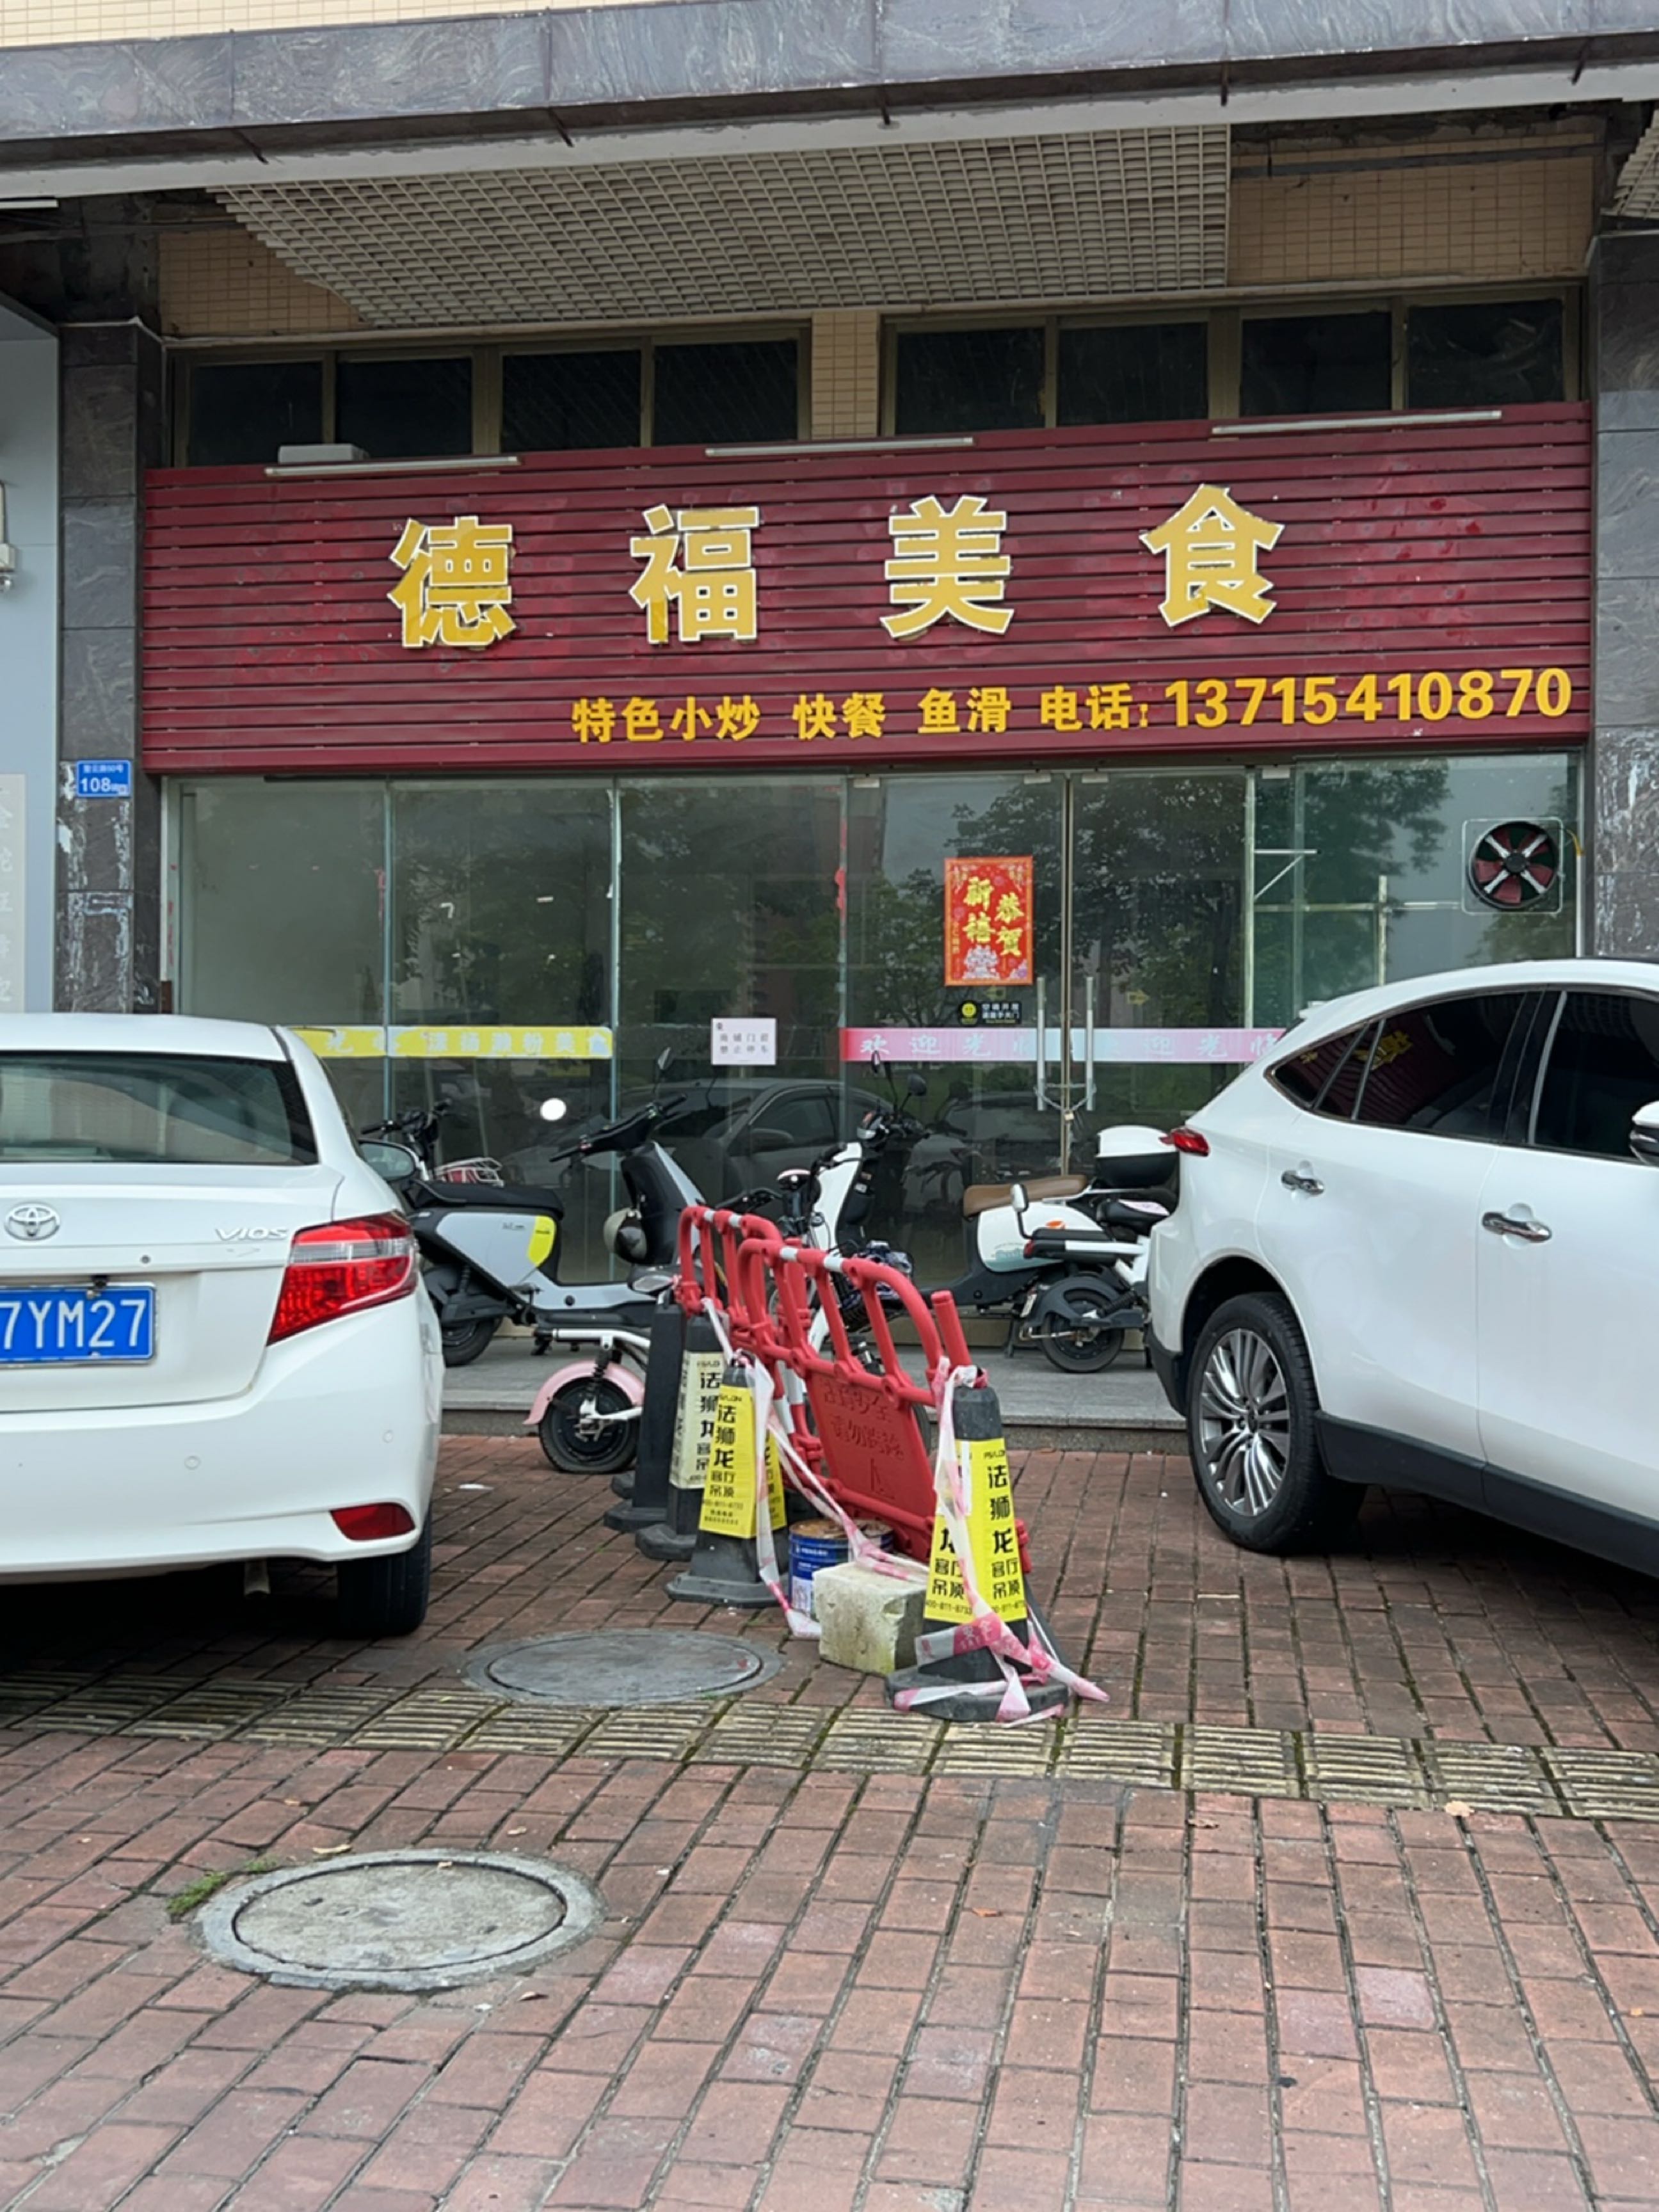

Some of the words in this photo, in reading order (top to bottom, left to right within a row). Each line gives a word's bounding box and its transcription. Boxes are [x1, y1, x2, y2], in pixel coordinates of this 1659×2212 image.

[387, 484, 1285, 648] 德福美食
[572, 695, 761, 743] 特色小炒
[792, 693, 885, 740] 快餐
[918, 686, 1011, 734] 鱼滑
[216, 1226, 290, 1240] VIOS
[987, 1464, 1014, 1554] 法狮龙
